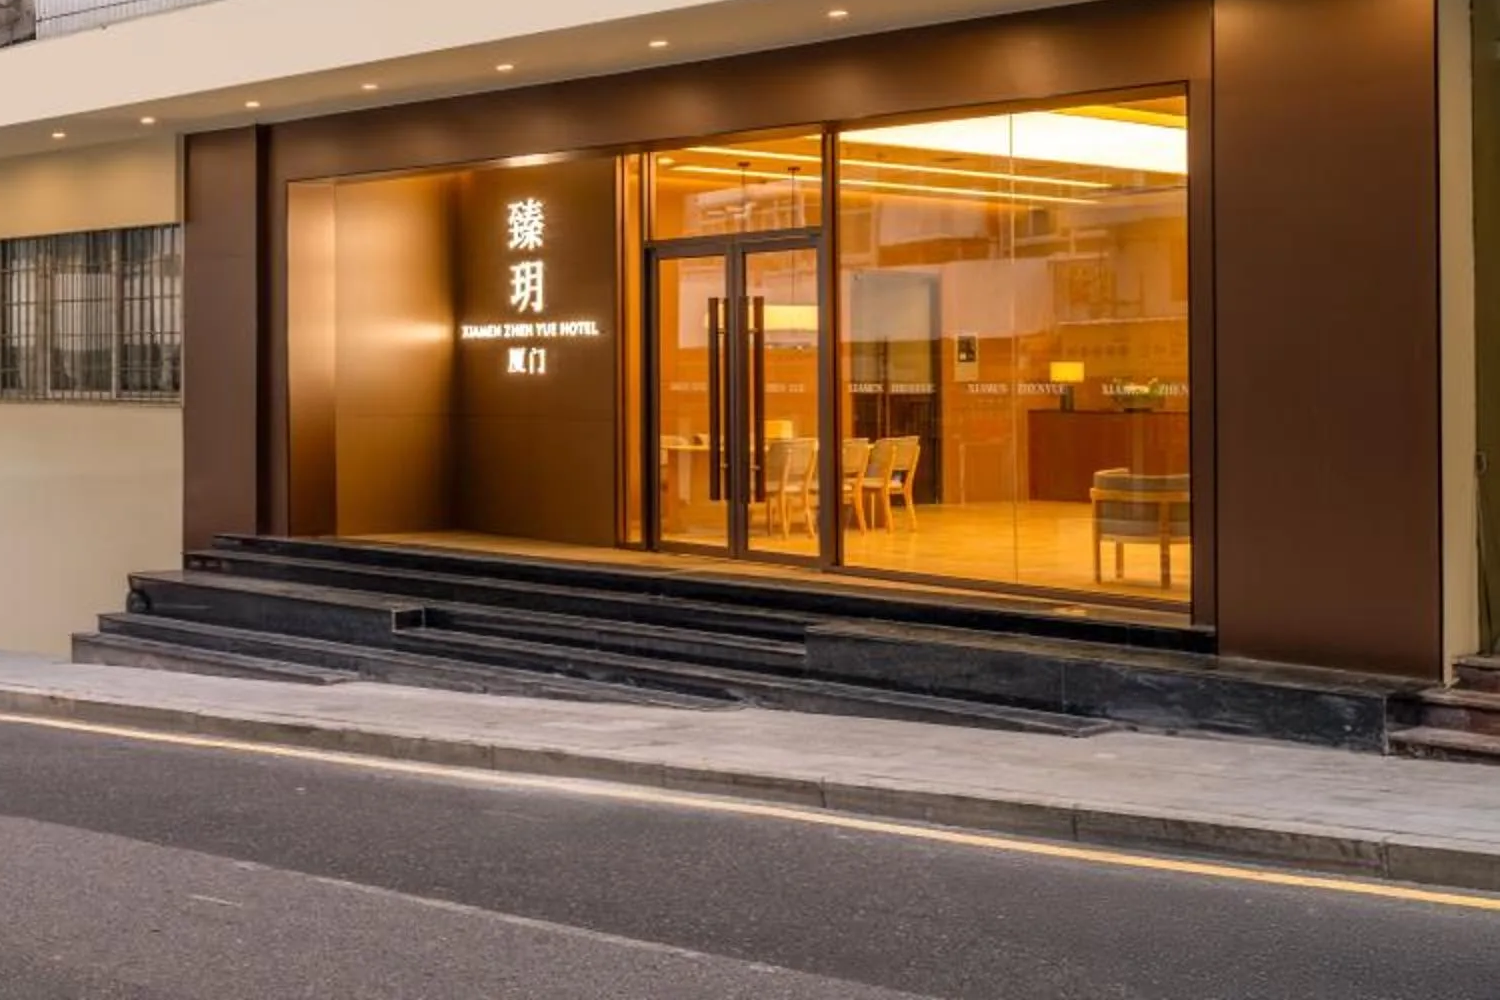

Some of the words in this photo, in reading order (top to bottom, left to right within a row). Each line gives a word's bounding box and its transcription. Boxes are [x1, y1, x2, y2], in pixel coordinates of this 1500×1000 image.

[507, 198, 545, 312] 臻玥
[461, 325, 502, 339] XIAMEN
[504, 323, 534, 337] ZHEN
[536, 322, 557, 337] YUE
[560, 321, 599, 336] HOTEL
[507, 348, 546, 373] 厦门
